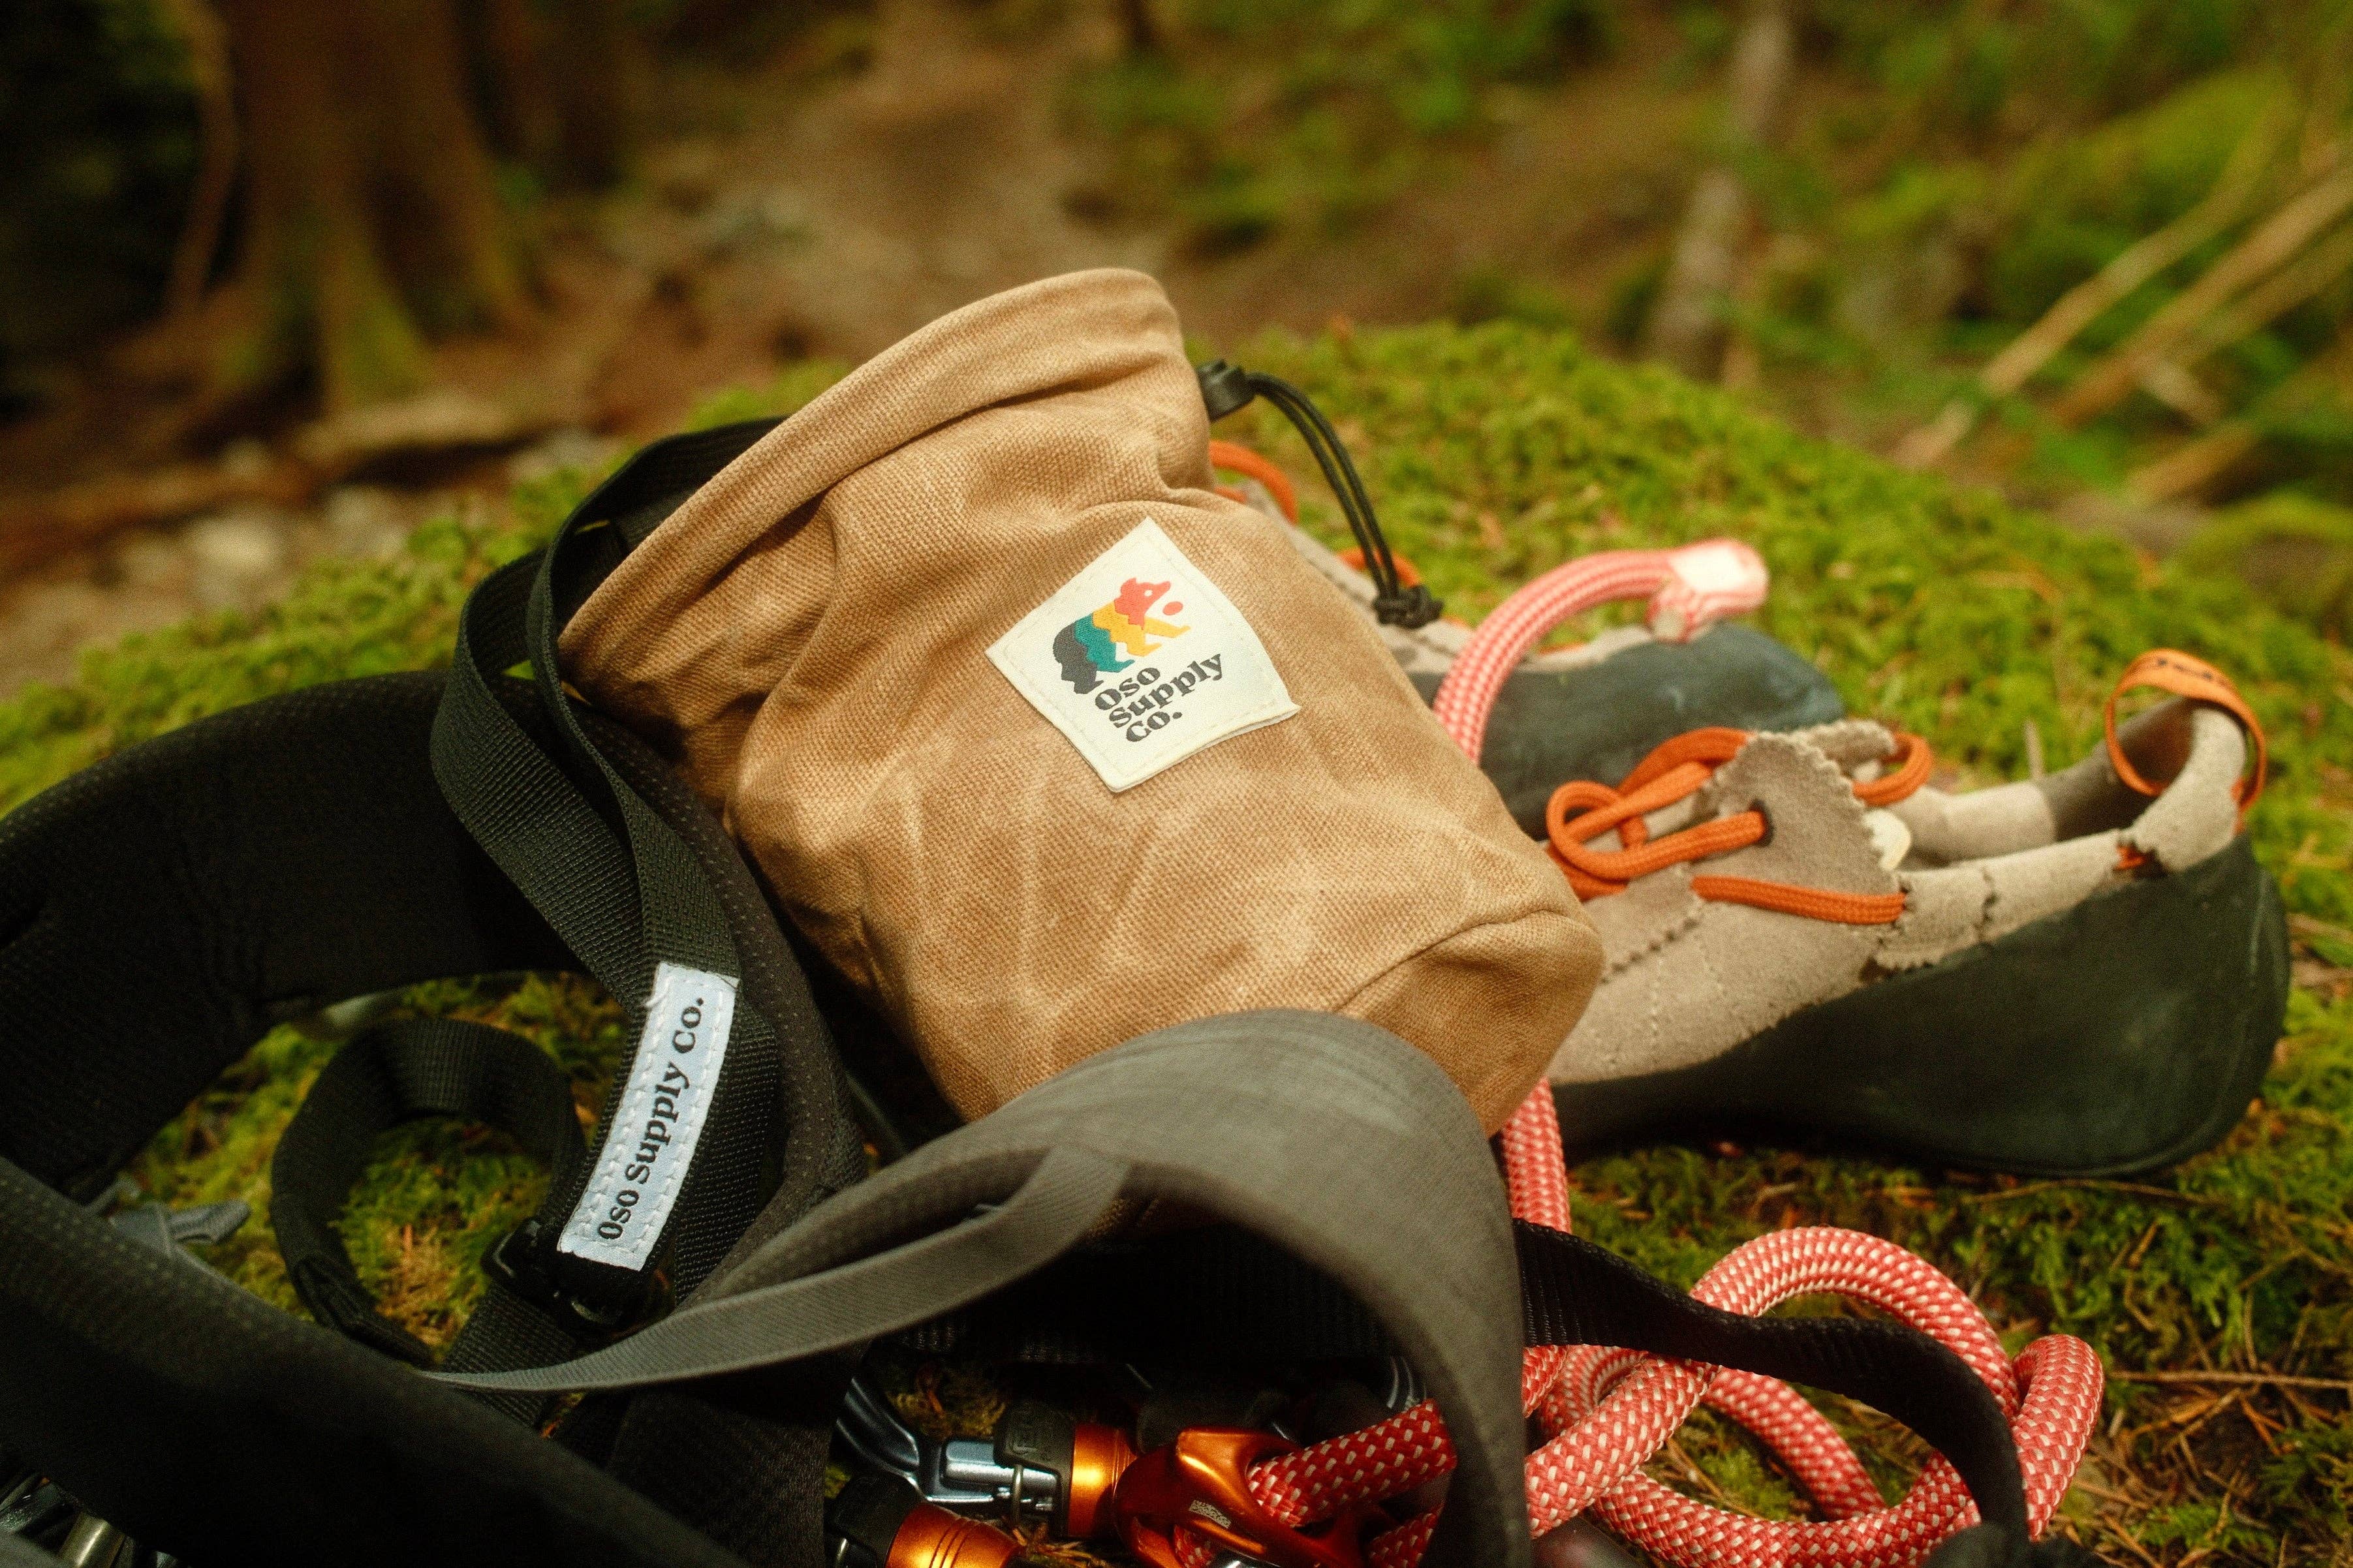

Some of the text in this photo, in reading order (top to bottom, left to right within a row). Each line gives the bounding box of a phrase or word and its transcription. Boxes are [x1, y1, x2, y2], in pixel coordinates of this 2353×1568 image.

[1095, 667, 1161, 711] Oso
[1109, 654, 1223, 728] Supply
[1126, 711, 1183, 742] Co.
[597, 997, 704, 1240] Oso Supply Co.
